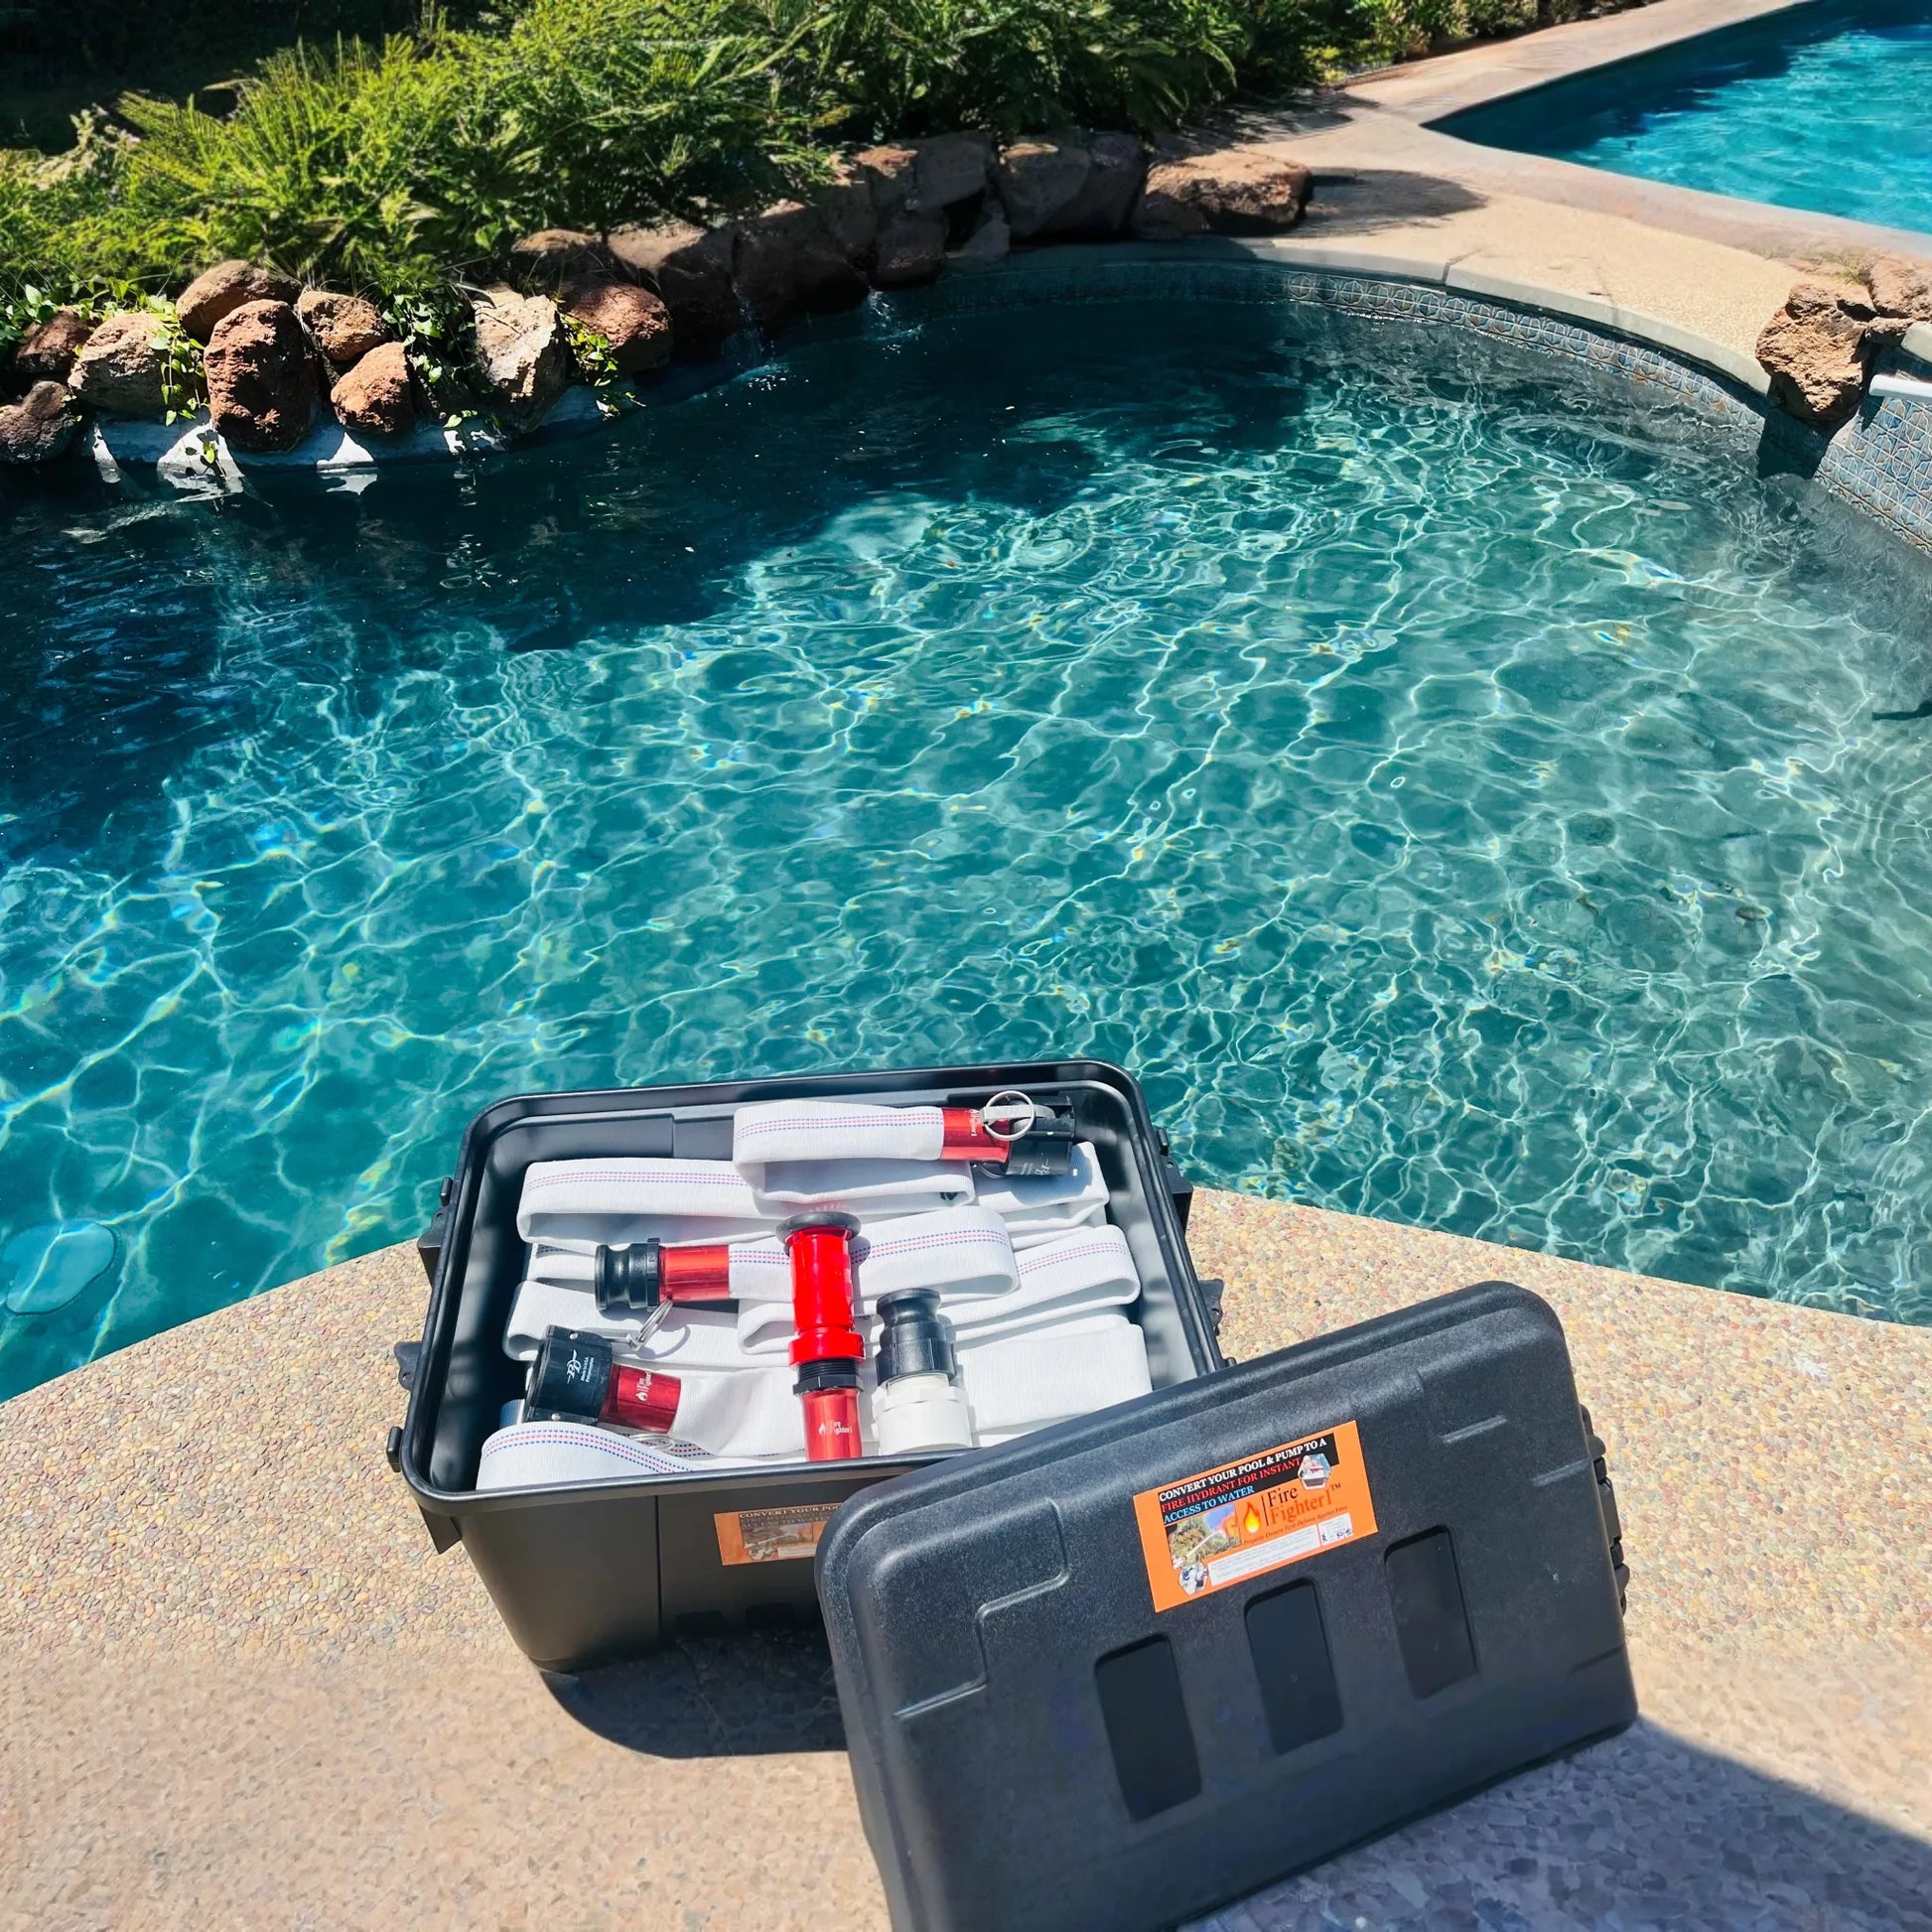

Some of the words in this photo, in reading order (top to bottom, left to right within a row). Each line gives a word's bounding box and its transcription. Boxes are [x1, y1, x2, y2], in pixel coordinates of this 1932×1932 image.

[1159, 1478, 1207, 1502] CONVERT
[1208, 1468, 1238, 1484] YOUR
[1238, 1459, 1266, 1475] POOL
[1266, 1455, 1275, 1465] &
[1275, 1445, 1305, 1461] PUMP
[1304, 1440, 1318, 1451] TO
[1318, 1437, 1327, 1448] A
[1161, 1497, 1186, 1512] FIRE
[1185, 1480, 1237, 1503] HYDRANT
[1237, 1473, 1259, 1486] FOR
[1260, 1456, 1303, 1478] INSTANT
[1164, 1504, 1201, 1524] ACCESS
[1201, 1498, 1217, 1509] TO
[1217, 1485, 1256, 1503] WATER
[1267, 1487, 1299, 1507] Fire
